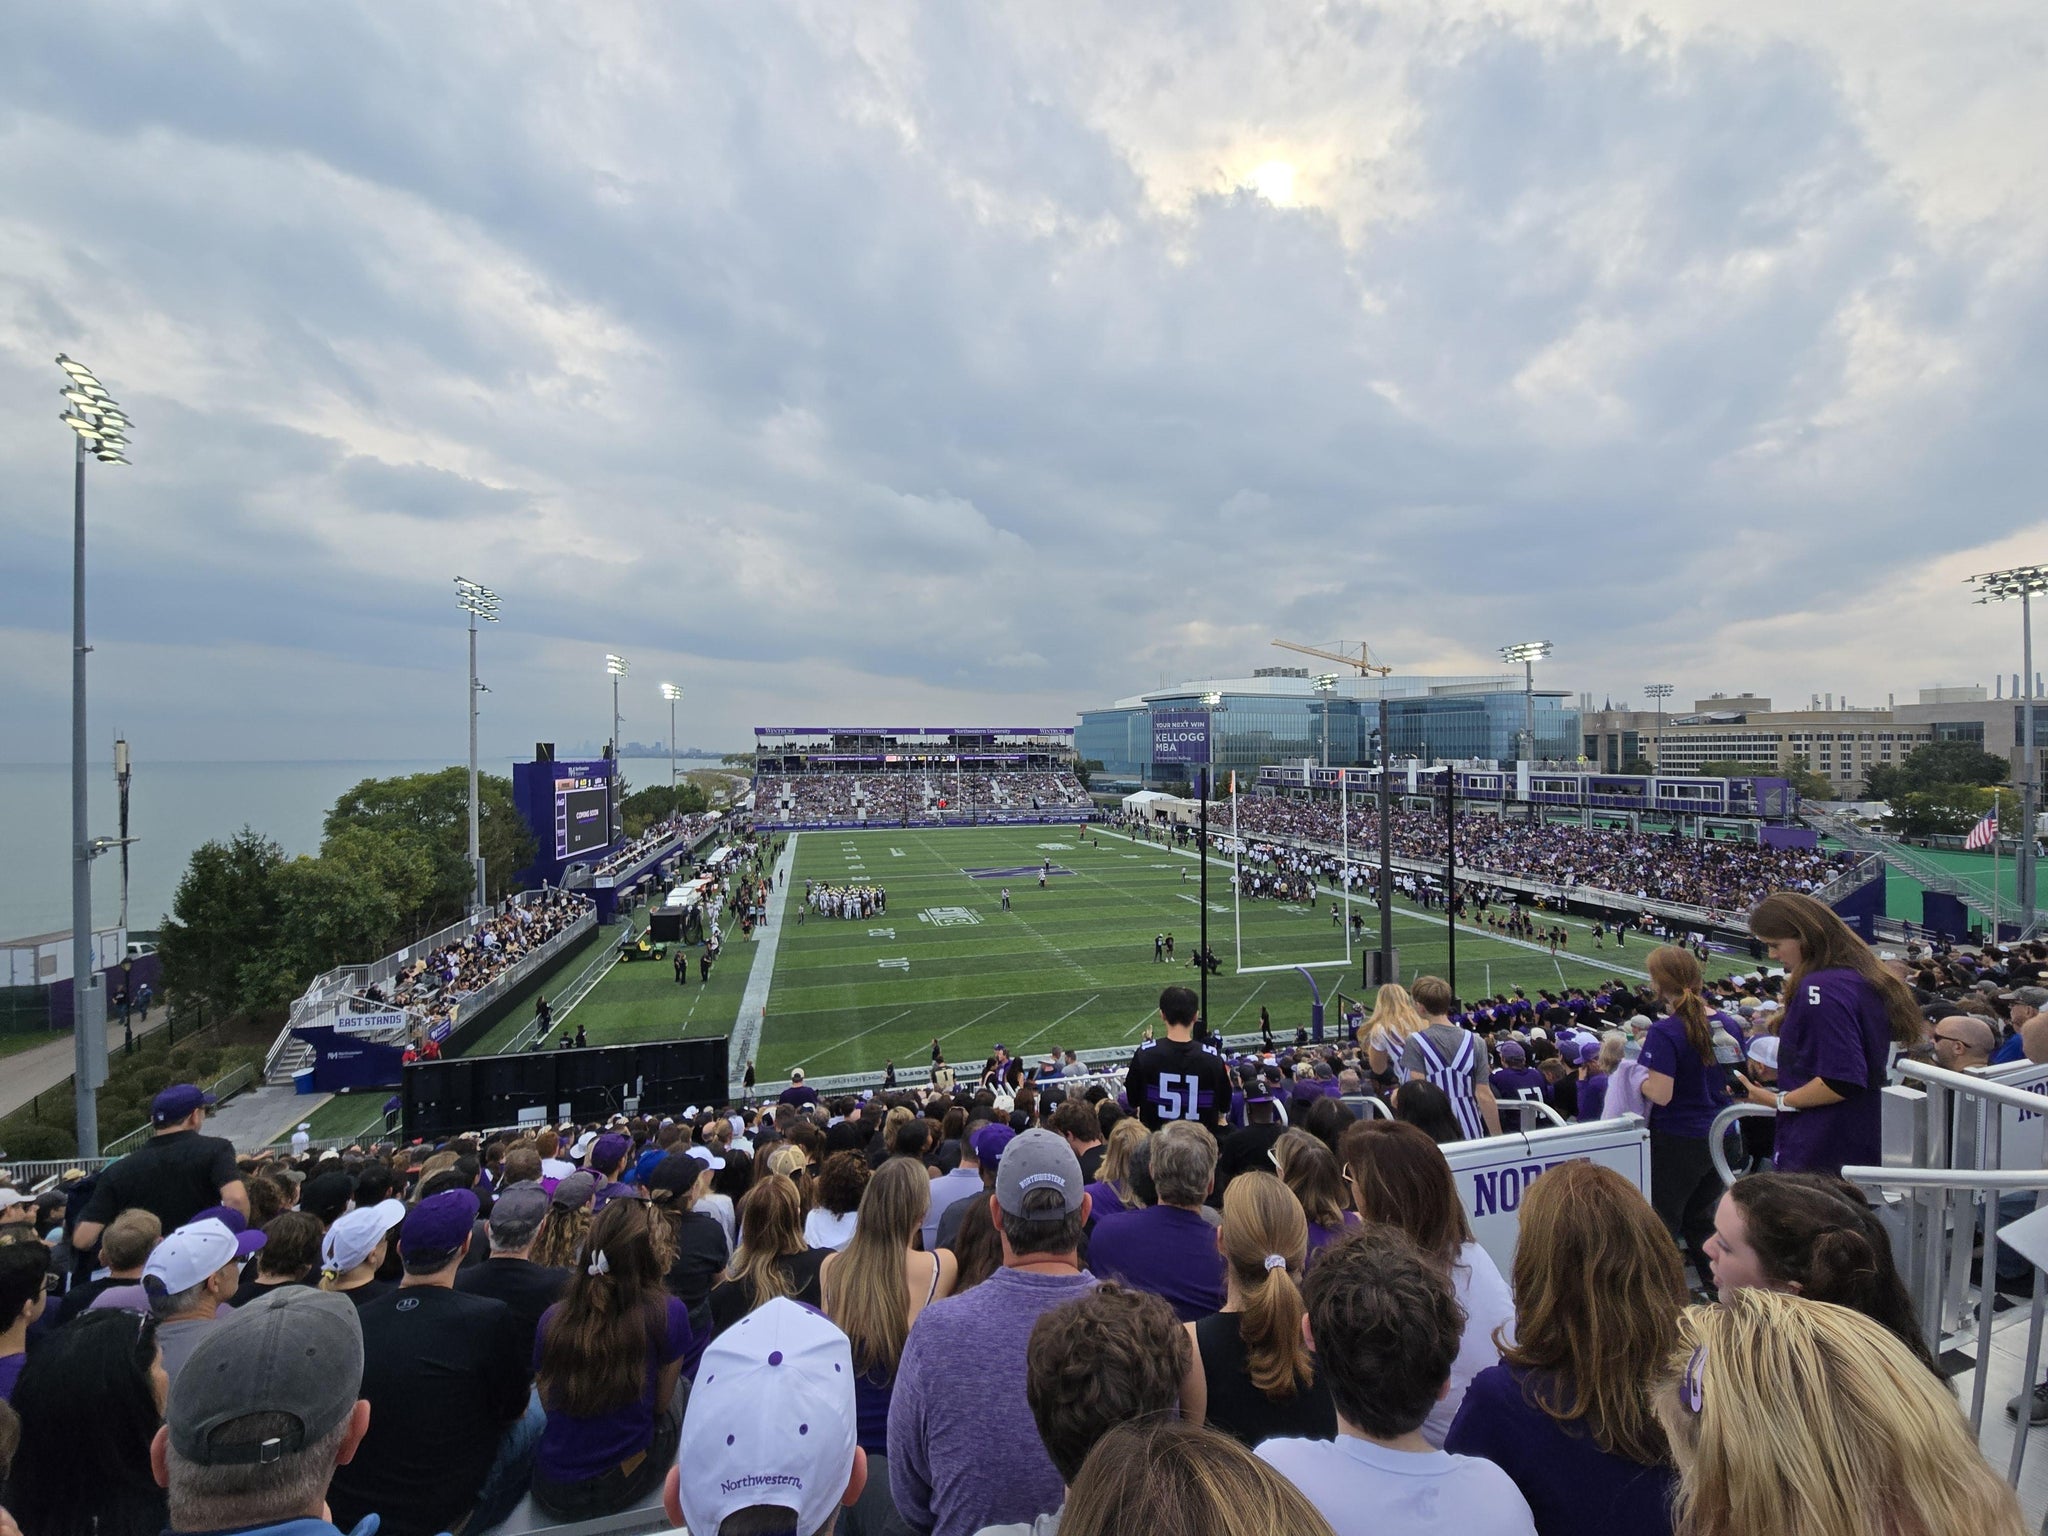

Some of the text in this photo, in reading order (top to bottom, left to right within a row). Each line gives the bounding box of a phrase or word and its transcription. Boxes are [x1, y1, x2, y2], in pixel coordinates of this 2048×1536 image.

[1155, 732, 1205, 742] KELLOGG
[1155, 742, 1177, 752] MBA
[1808, 985, 1821, 1005] 5
[339, 1014, 402, 1028] EAST STANDS
[942, 1071, 949, 1082] 1
[1158, 1072, 1200, 1120] 51
[720, 1474, 801, 1495] Northwestern
